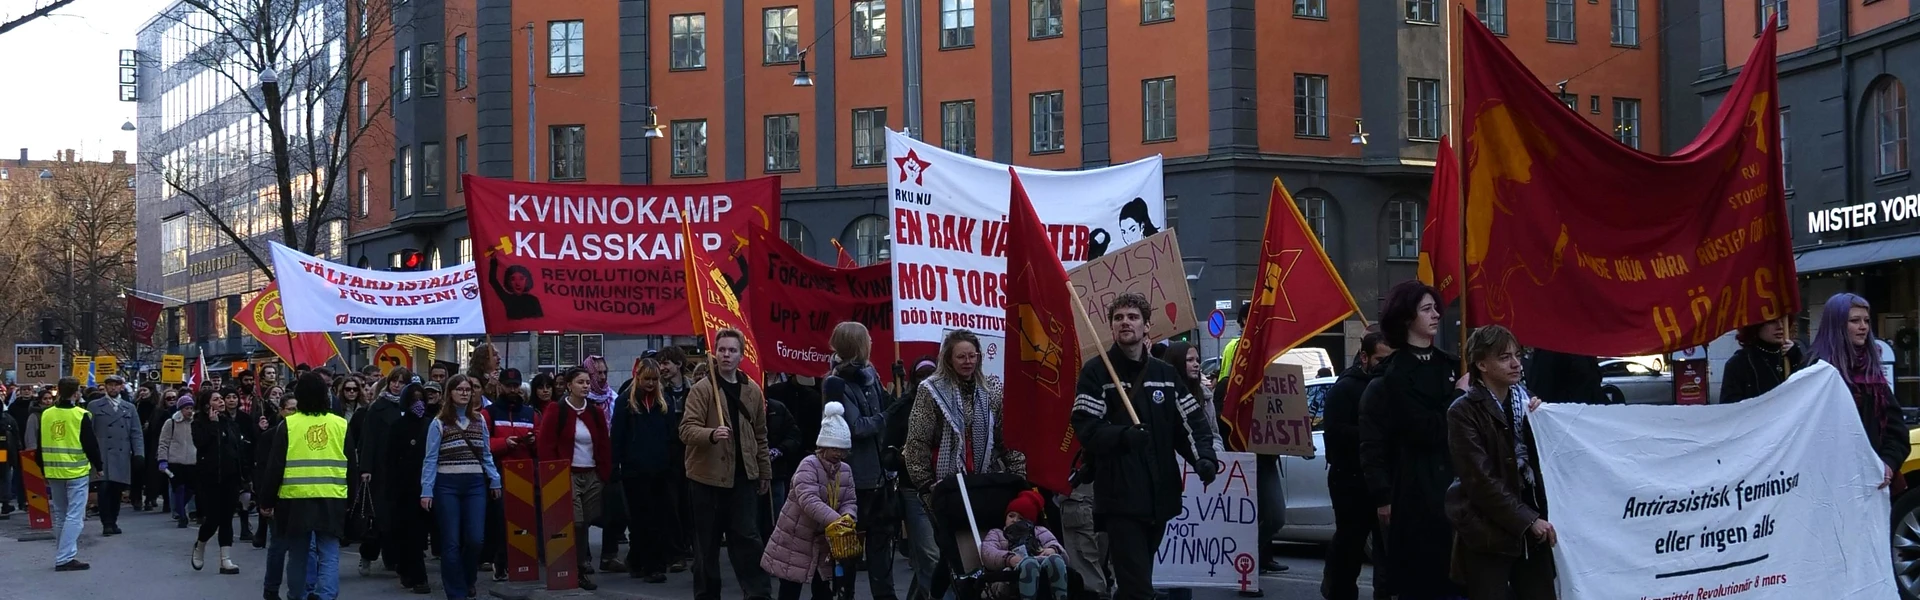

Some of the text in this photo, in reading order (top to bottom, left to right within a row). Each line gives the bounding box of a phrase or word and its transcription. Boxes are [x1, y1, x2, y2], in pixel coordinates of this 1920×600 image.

[119, 49, 137, 101] ABF
[508, 194, 733, 225] KVINNOKAMP
[1808, 202, 1877, 233] MISTER
[895, 207, 1090, 262] EN RAK VÄTER
[541, 266, 686, 285] REVOLUTIONÄR
[1067, 233, 1175, 300] SEXISM
[1650, 251, 1691, 279] VÅRA
[544, 282, 686, 300] KOMMUNISTISK
[898, 262, 949, 302] MOT
[338, 287, 458, 307] FÖR VAPEN!
[573, 299, 656, 316] UNGDOM
[350, 316, 425, 326] KOMMUNISTISKA
[426, 316, 460, 326] PARTIET
[901, 306, 928, 325] DÖD
[930, 306, 943, 325] ÅT
[17, 346, 44, 355] DEATH
[1267, 396, 1284, 414] ÄR
[1250, 415, 1312, 447] BÄST!
[1196, 493, 1257, 525] VÅLD
[1622, 485, 1731, 520] Antirasistisk
[1166, 522, 1200, 538] MOT
[1655, 514, 1776, 555] eller ingen alls
[1696, 575, 1753, 600] Revolutionär
[1754, 575, 1760, 588] 8
[1761, 573, 1787, 587] mars
